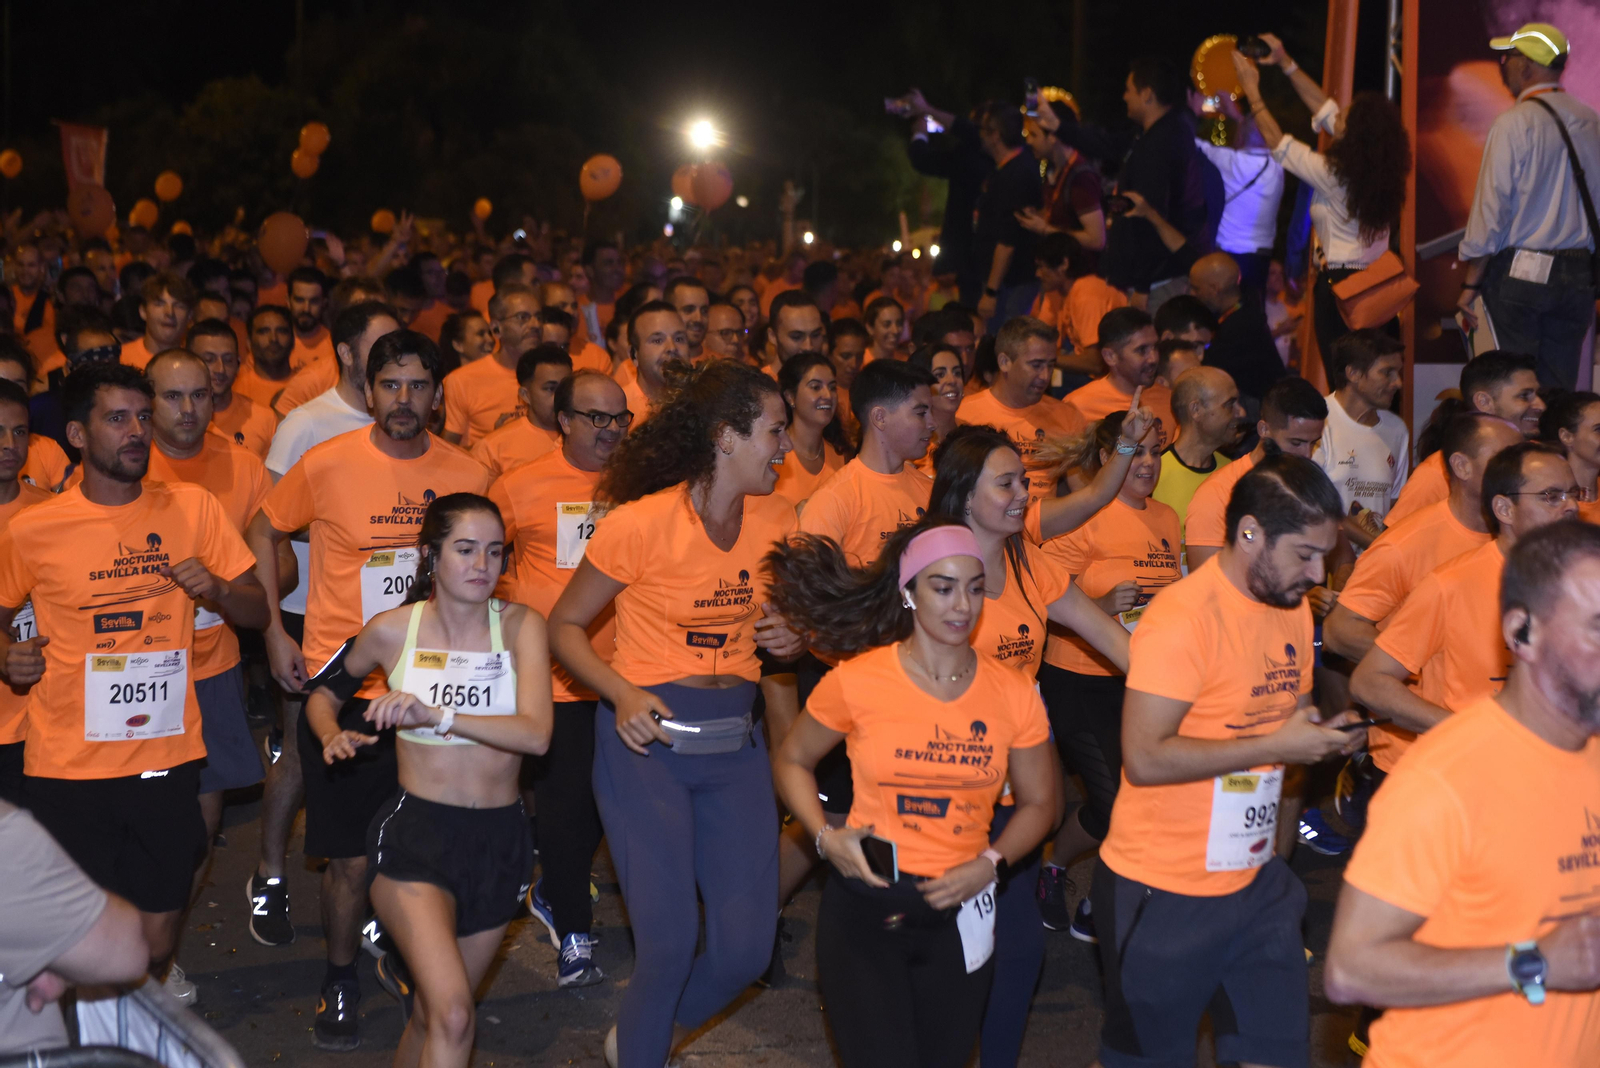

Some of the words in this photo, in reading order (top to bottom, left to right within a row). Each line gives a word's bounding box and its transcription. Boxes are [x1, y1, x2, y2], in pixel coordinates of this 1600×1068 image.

[370, 515, 413, 525] SEVILLA
[114, 553, 169, 567] NOCTURNA
[1133, 560, 1165, 568] SEVILLA
[89, 567, 140, 581] SEVILLA
[714, 587, 754, 598] NOCTURNA
[693, 599, 732, 609] SEVILLA
[733, 595, 753, 606] KH7
[997, 639, 1035, 653] NOCTURNA
[109, 680, 168, 704] 20511
[429, 682, 491, 708] 16561
[926, 740, 994, 754] NOCTURNA
[894, 748, 956, 765] SEVILLA
[959, 754, 992, 768] KH7
